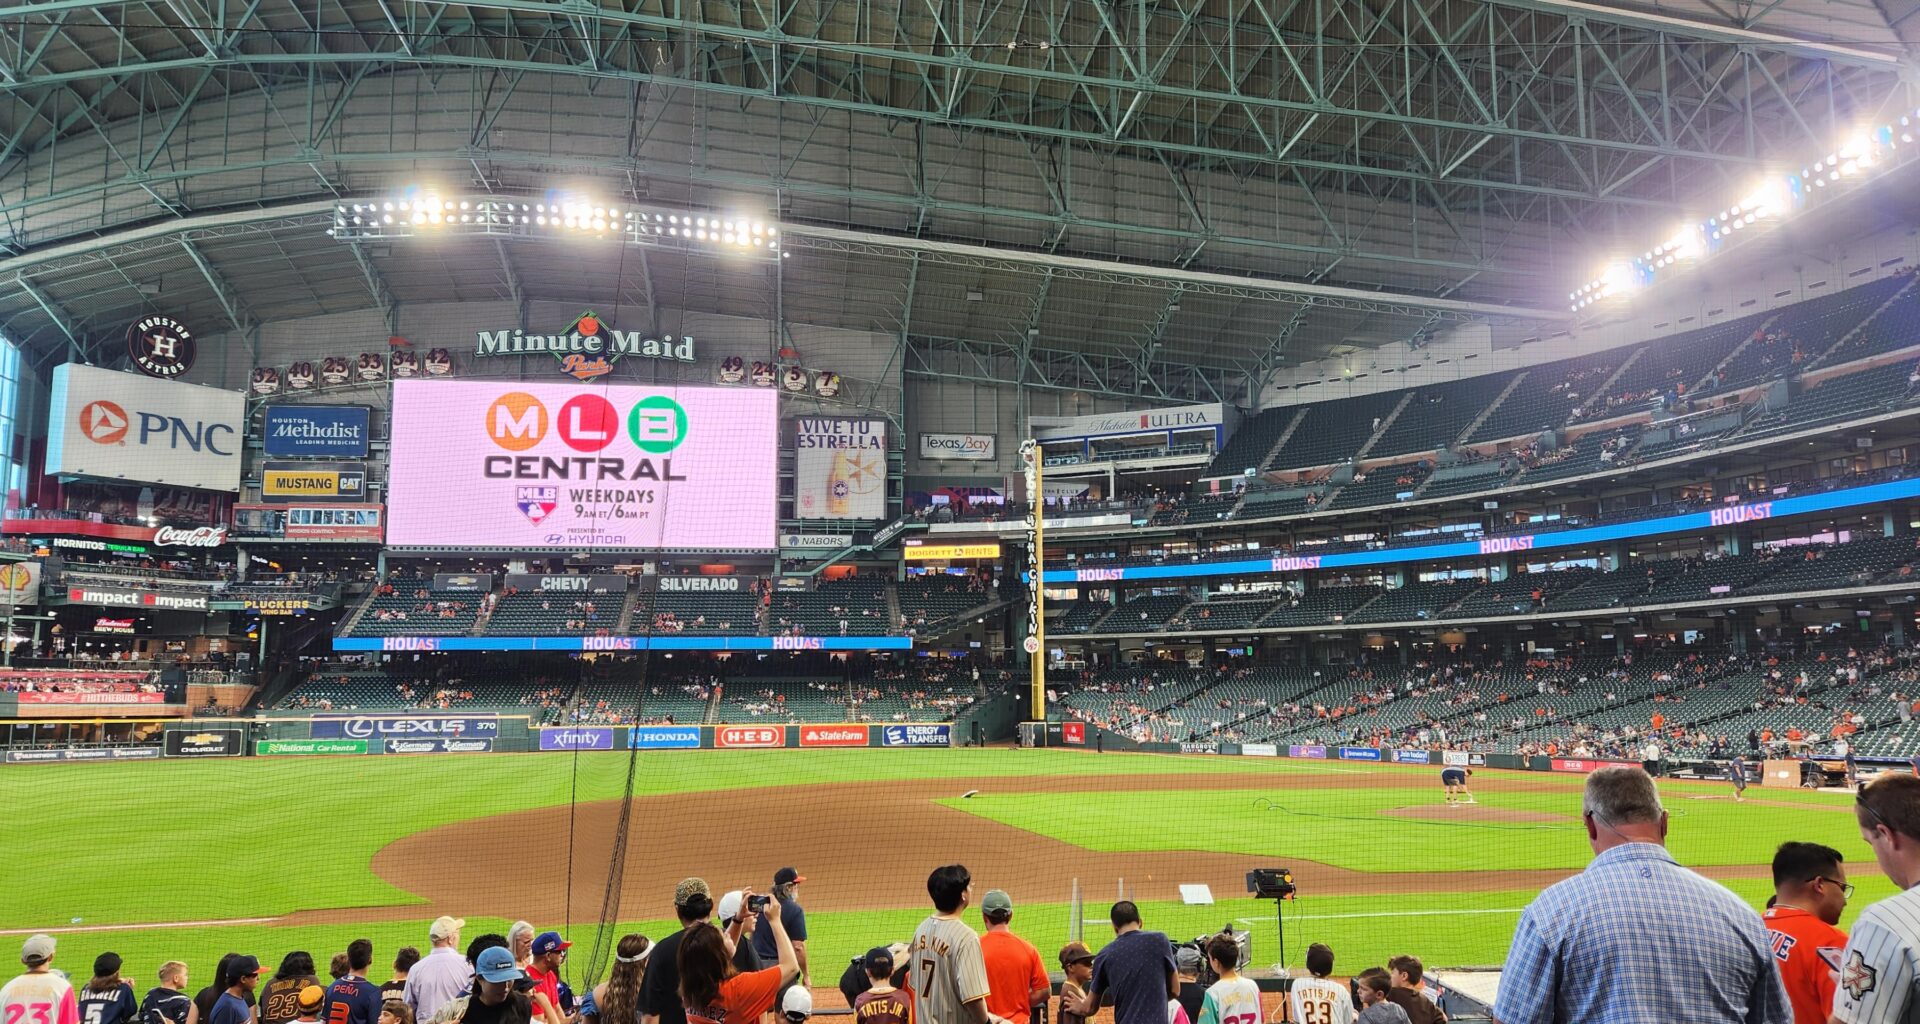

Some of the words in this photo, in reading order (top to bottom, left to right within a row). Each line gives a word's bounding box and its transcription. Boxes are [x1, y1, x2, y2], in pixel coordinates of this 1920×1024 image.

[139, 317, 190, 339] HOUSTON
[152, 335, 177, 358] H
[476, 330, 601, 355] Minute
[610, 331, 695, 360] Maid
[359, 353, 382, 369] 33
[392, 351, 416, 366] 34
[426, 348, 448, 364] 42
[721, 356, 743, 372] 49
[139, 356, 184, 375] ASTROS
[289, 362, 312, 378] 40
[323, 357, 347, 373] 25
[560, 354, 612, 375] Park
[753, 361, 774, 376] 24
[254, 367, 277, 383] 32
[791, 366, 800, 381] 5
[822, 371, 833, 386] 7
[272, 422, 360, 438] Methodist
[802, 419, 842, 434] VIVE
[847, 419, 870, 435] TU
[1088, 417, 1138, 433] Michelob
[1151, 411, 1208, 428] ULTRA
[137, 411, 235, 456] PNC
[798, 434, 880, 450] ESTRELLA
[925, 435, 960, 449] Texas
[965, 436, 991, 453] Bay
[484, 455, 687, 482] CENTRAL
[276, 478, 332, 489] MUSTANG
[340, 477, 361, 490] CAT
[518, 486, 556, 500] MLB
[569, 488, 654, 504] WEEKDAYS
[574, 504, 597, 518] 9AM
[1710, 502, 1772, 526] HOUAST
[53, 538, 105, 550] HORNITOS
[569, 535, 626, 544] HYUNDAI
[802, 537, 843, 546] NABORS
[1027, 531, 1037, 564] THA
[1480, 535, 1534, 555] HOUAST
[965, 548, 993, 556] RENTS
[1271, 556, 1321, 571] HOUAST
[1077, 569, 1124, 582] HOUAST
[541, 577, 592, 591] CHEVY
[660, 577, 738, 591] SILVERADO
[82, 588, 138, 604] impact
[155, 593, 206, 609] impact
[245, 600, 309, 608] PLUCKERS
[1028, 569, 1038, 634] CHIKIN
[384, 637, 441, 650] HOUAST
[583, 637, 637, 650] HOUAST
[773, 637, 826, 649] HOUAST
[378, 719, 465, 732] LEXUS
[906, 726, 939, 735] ENERGY
[553, 731, 600, 747] xfinity
[643, 733, 698, 741] HONDA
[906, 735, 947, 743] TRANSFER
[279, 743, 313, 751] National
[331, 743, 357, 751] Rental
[931, 935, 949, 957] KIM
[922, 959, 936, 998] 7
[333, 983, 359, 997] PEÑA
[1297, 988, 1324, 1000] TATIS
[4, 1003, 53, 1024] 23
[83, 1003, 105, 1024] 5
[266, 992, 300, 1019] 23
[328, 1001, 350, 1024] 3
[860, 1000, 888, 1017] TATIS
[1303, 1001, 1332, 1024] 23
